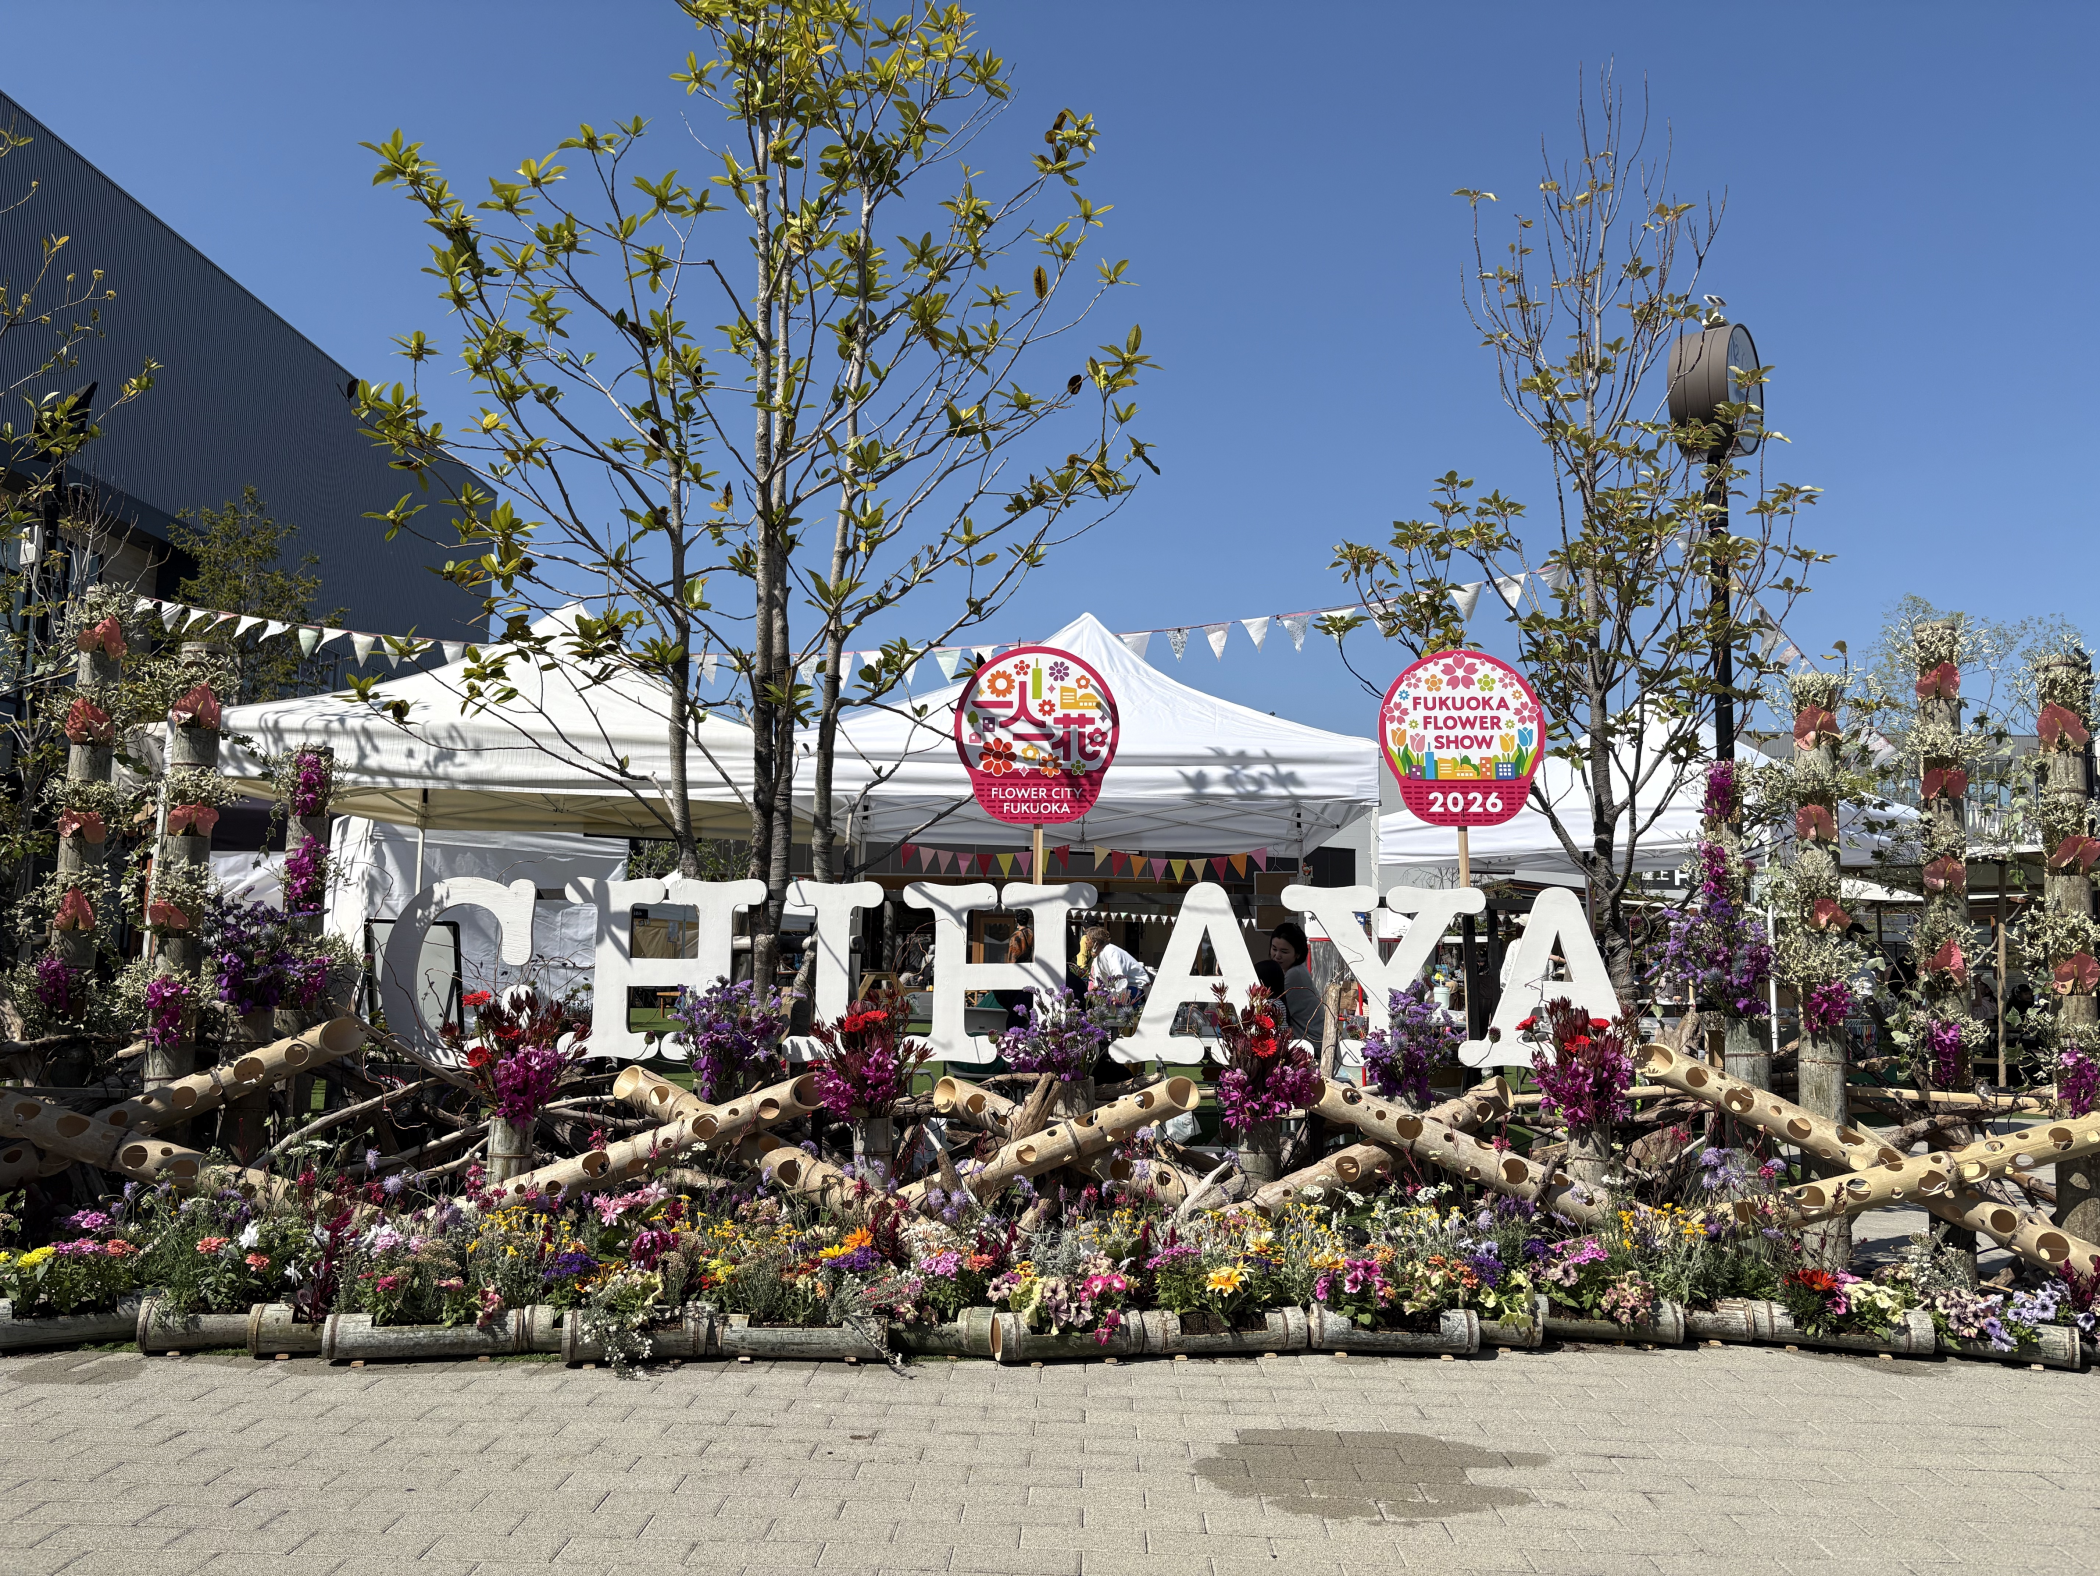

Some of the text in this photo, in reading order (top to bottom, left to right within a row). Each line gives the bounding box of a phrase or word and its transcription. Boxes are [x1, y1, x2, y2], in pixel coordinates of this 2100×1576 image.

[1412, 696, 1511, 711] FUKUOKA
[1422, 715, 1503, 731] FLOWER
[1433, 735, 1494, 750] SHOW
[991, 787, 1084, 799] FLOWER CITY
[1003, 802, 1071, 814] FUKUOKA
[1427, 791, 1503, 813] 2026
[380, 876, 1622, 1068] CHIHAYA
